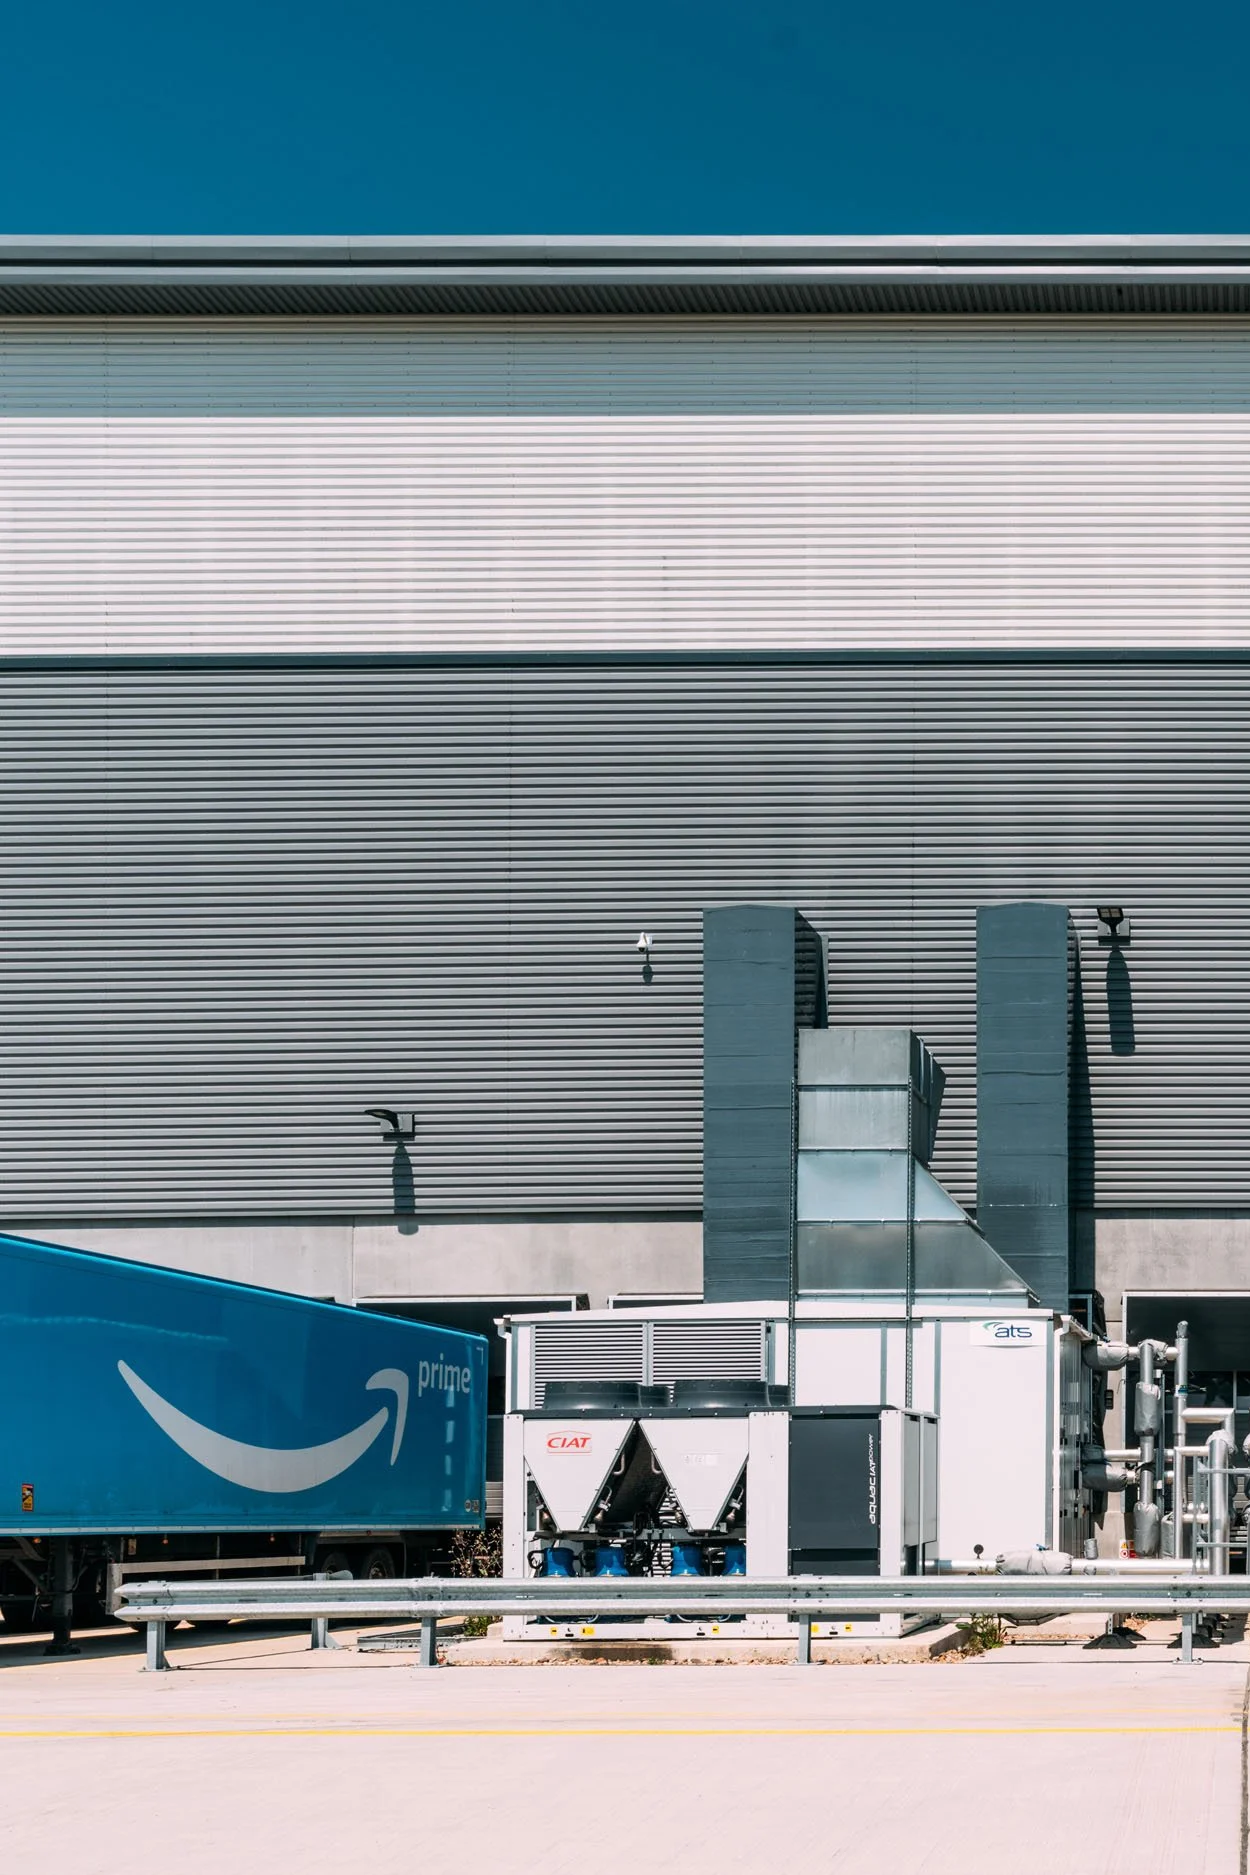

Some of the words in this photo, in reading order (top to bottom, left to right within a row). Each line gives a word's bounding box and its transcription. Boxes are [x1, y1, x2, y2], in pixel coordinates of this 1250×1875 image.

[994, 1324, 1033, 1338] ats
[418, 1352, 471, 1398] prime
[547, 1437, 591, 1448] CIAT
